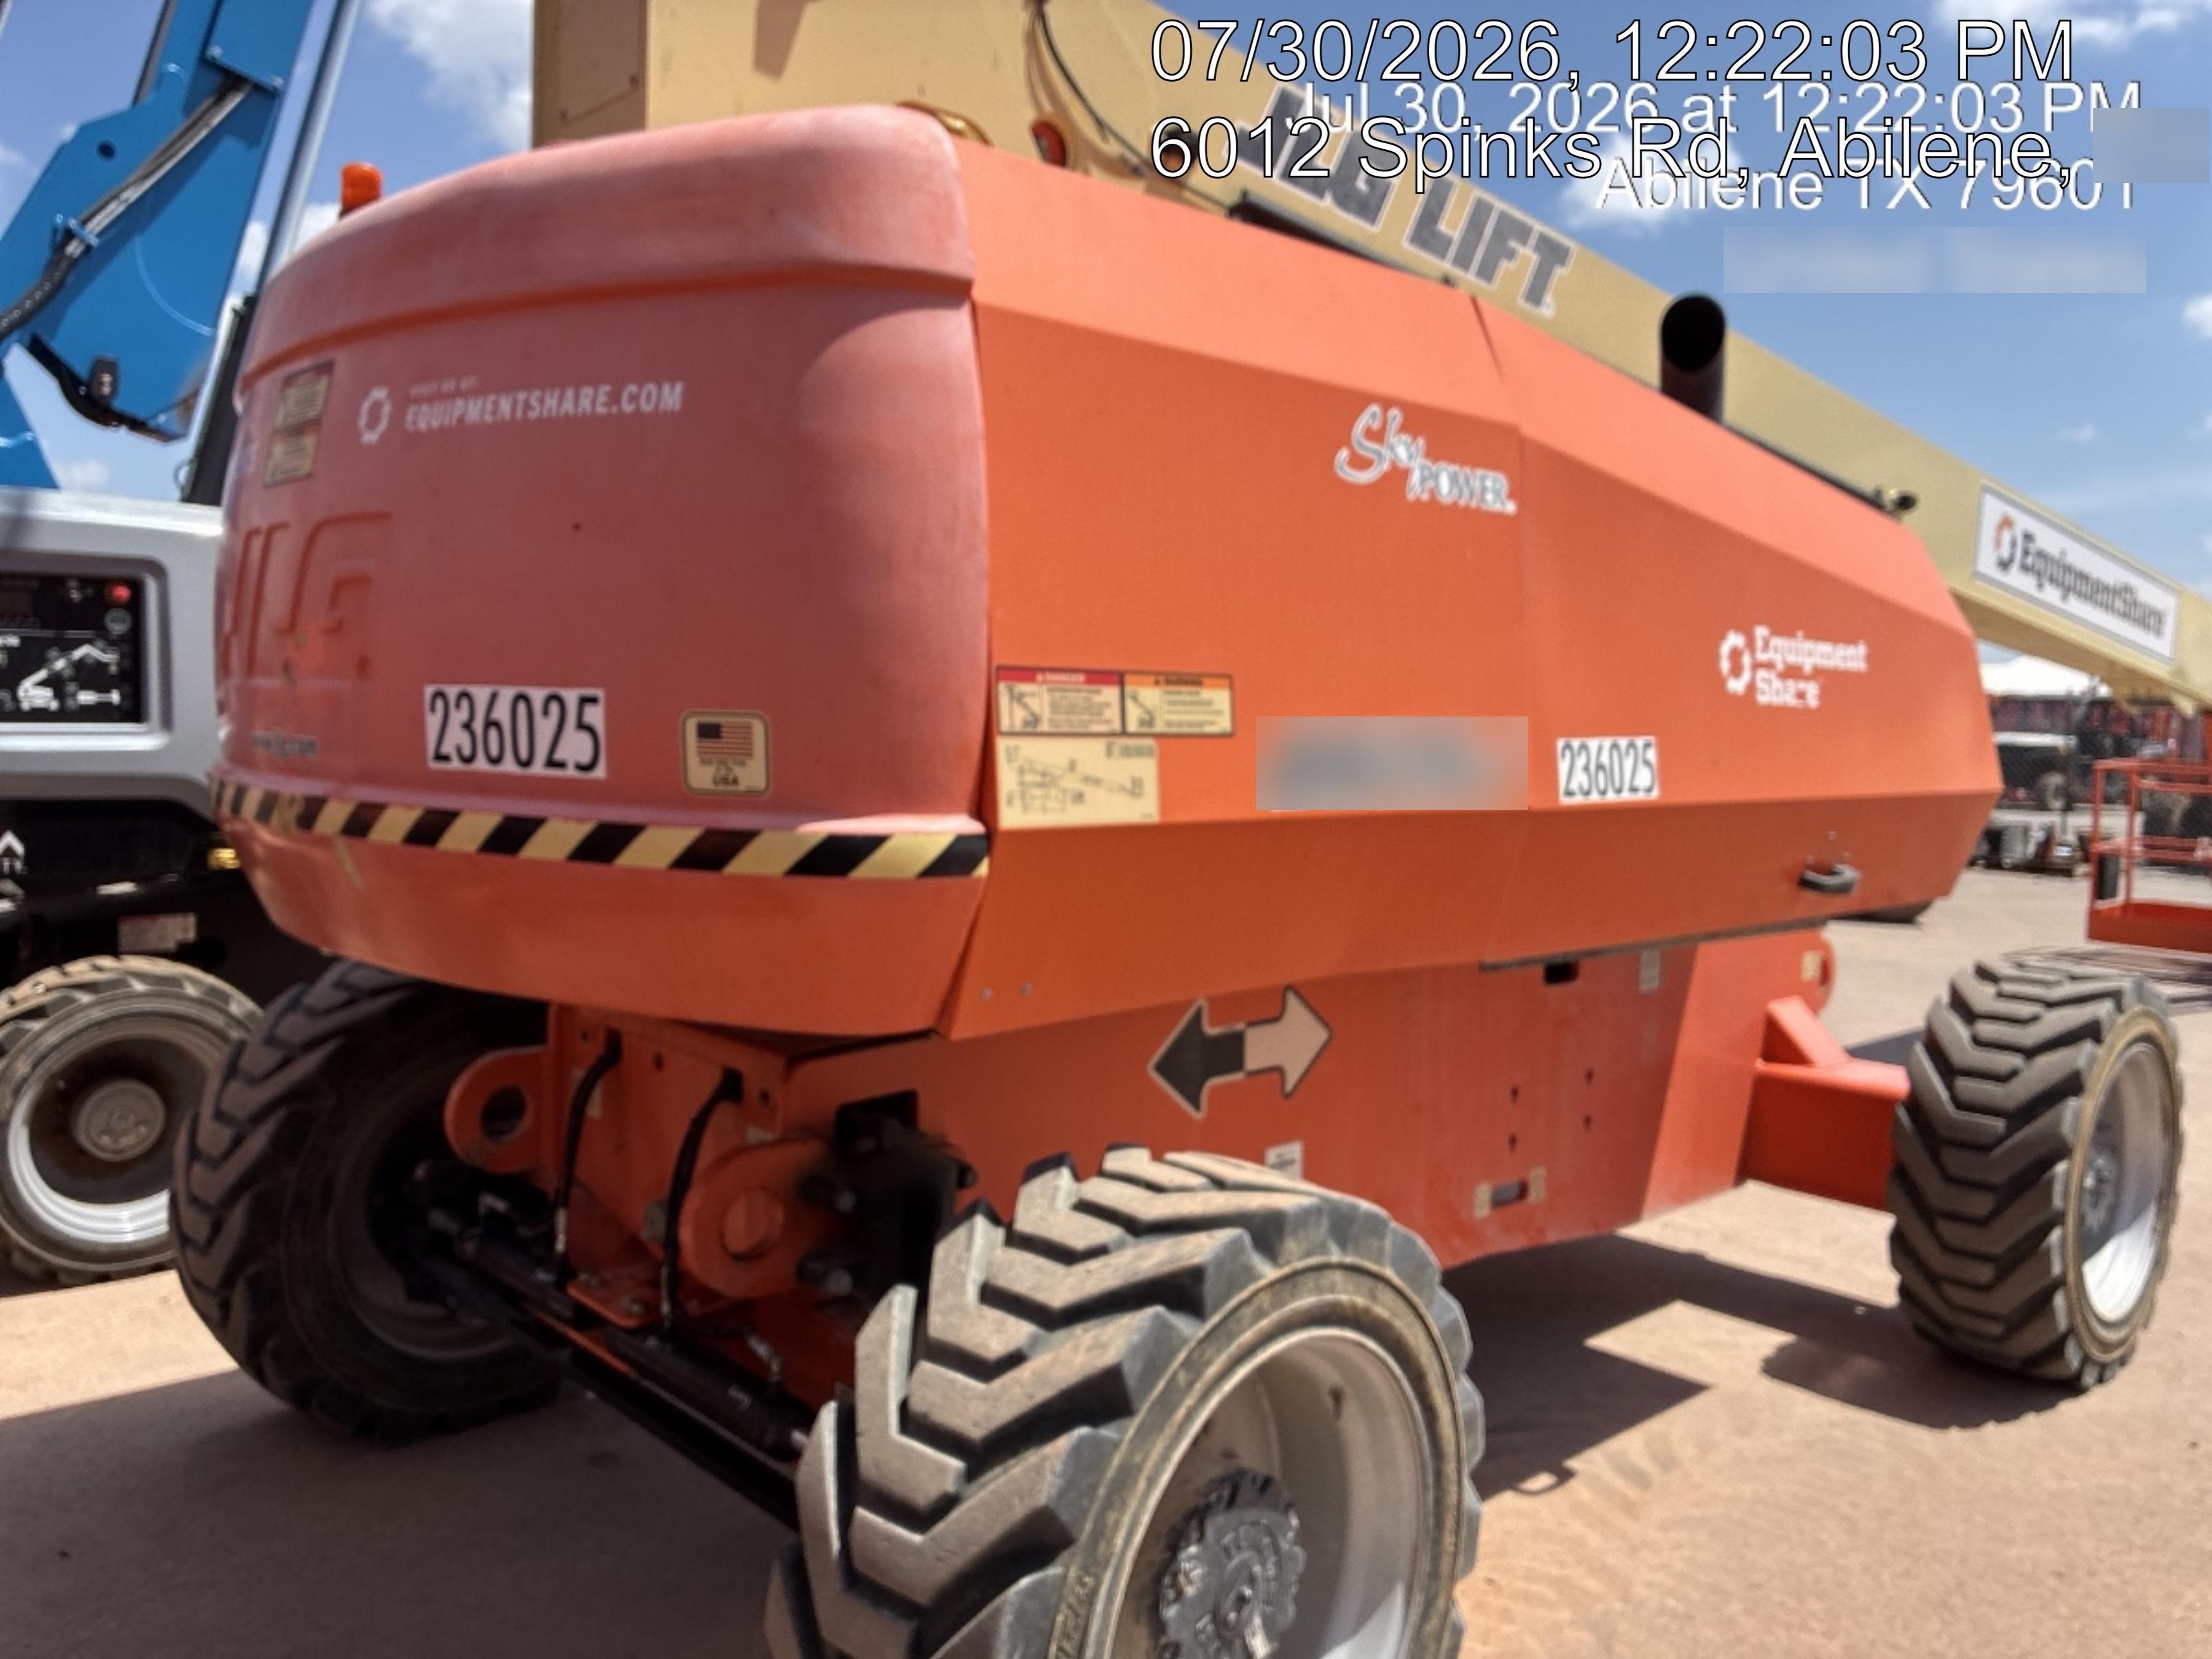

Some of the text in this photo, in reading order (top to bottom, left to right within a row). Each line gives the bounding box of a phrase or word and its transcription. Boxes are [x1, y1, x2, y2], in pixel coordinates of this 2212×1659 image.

[1401, 173, 1579, 317] LIFT
[404, 380, 685, 433] EQUIPMENTSHARE.COM
[1754, 624, 1869, 674] Equipment
[429, 689, 600, 773] 236025
[1561, 739, 1655, 797] 236025
